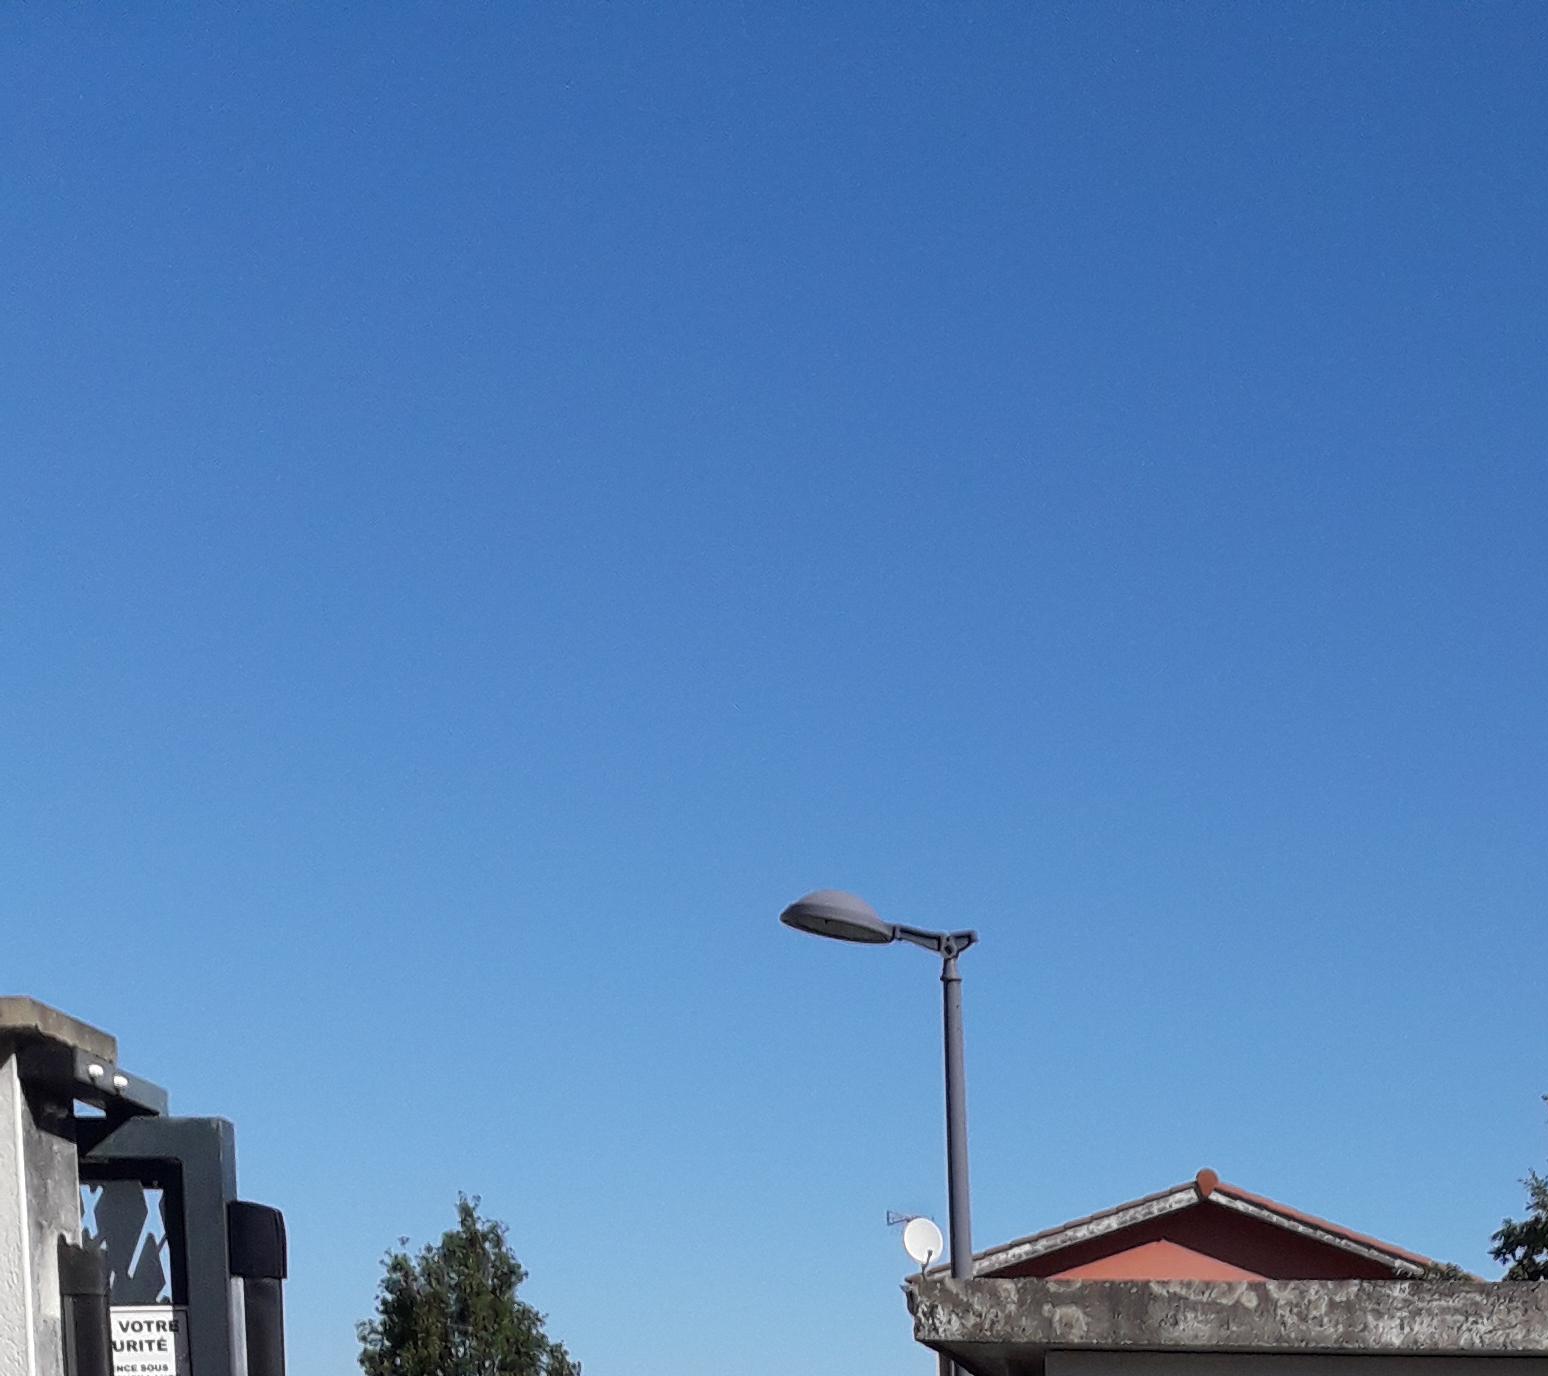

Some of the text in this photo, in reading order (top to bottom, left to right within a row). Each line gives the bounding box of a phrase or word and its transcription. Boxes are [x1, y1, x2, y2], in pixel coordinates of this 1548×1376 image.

[118, 1320, 179, 1333] VOTRE
[112, 1336, 168, 1352] URITÉ
[116, 1364, 169, 1372] NCE SOUS
